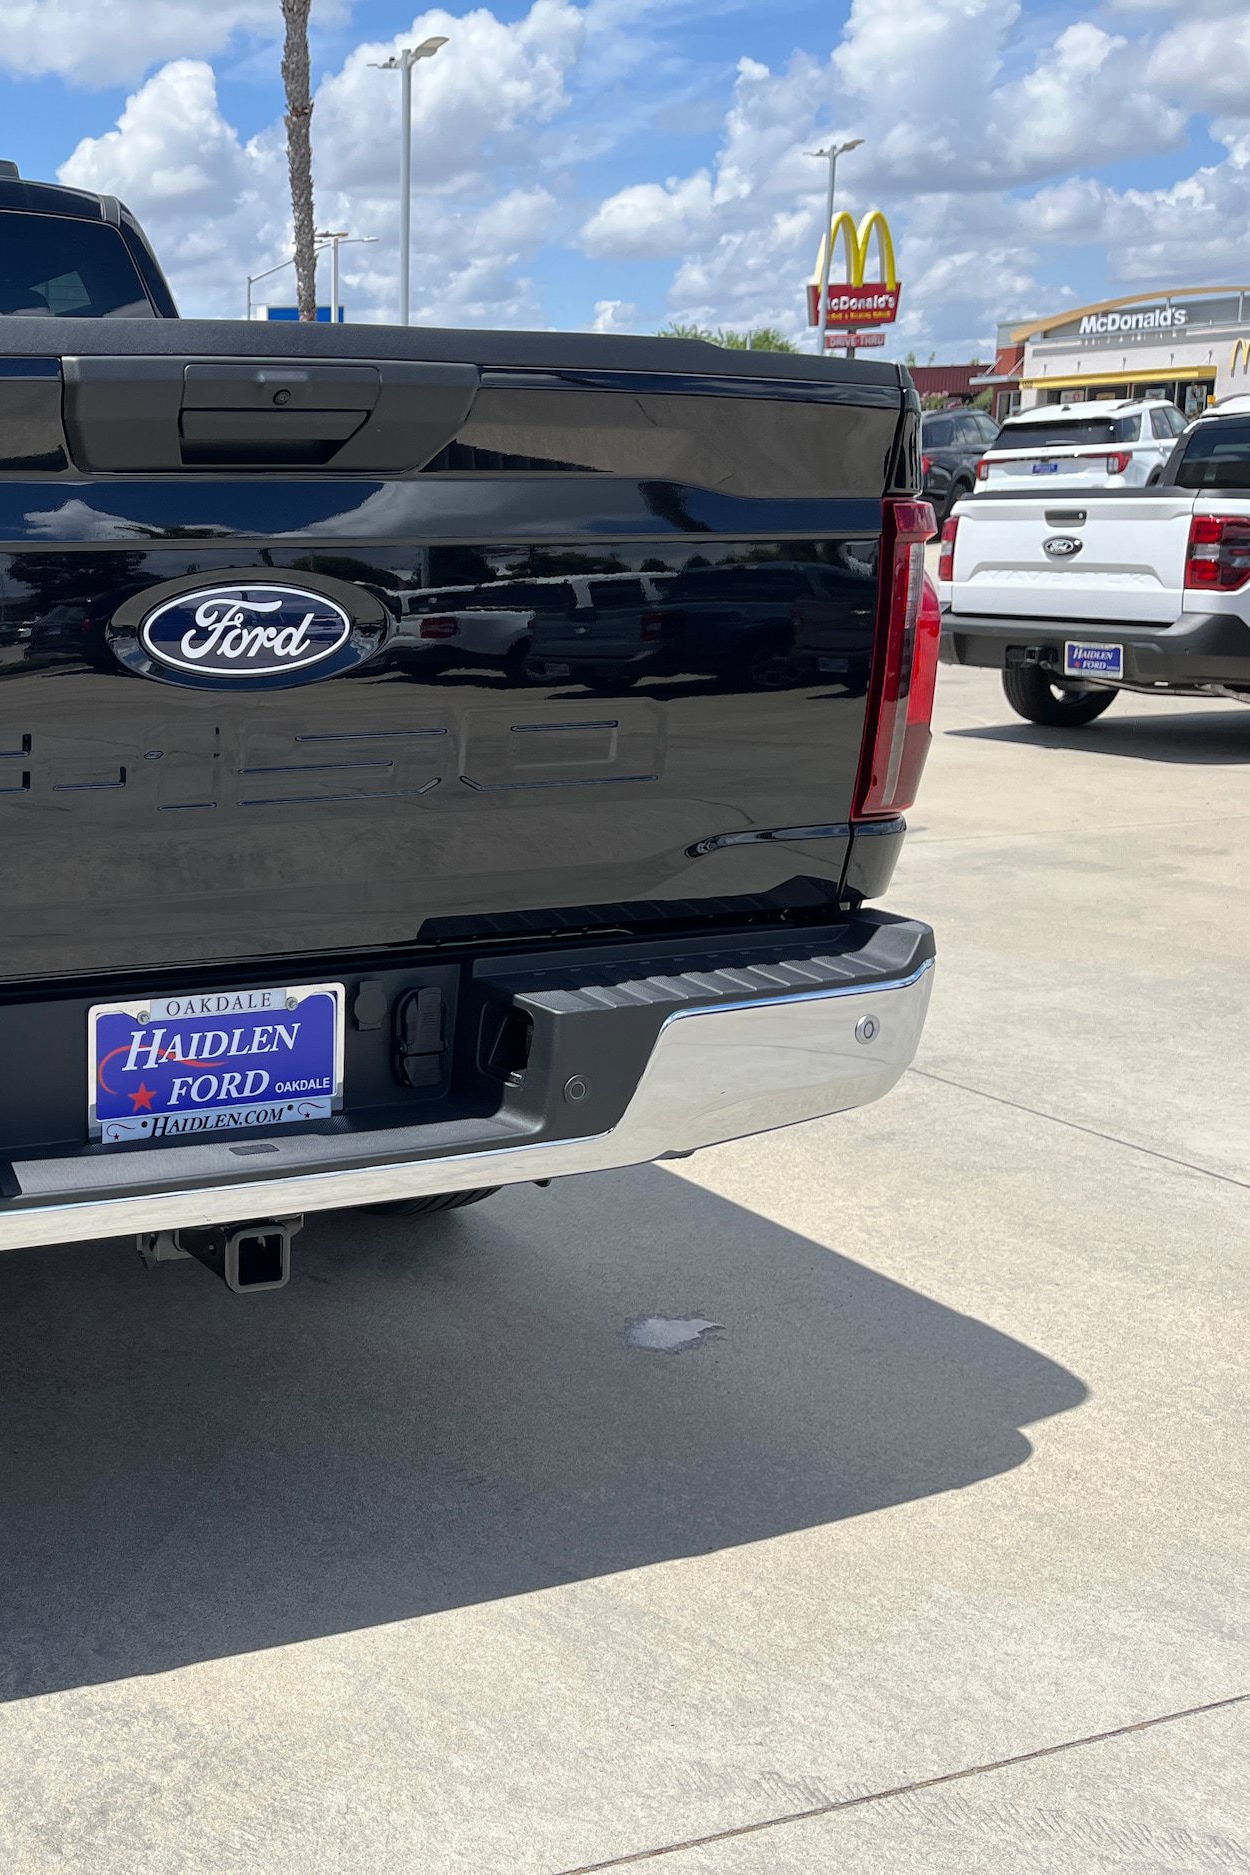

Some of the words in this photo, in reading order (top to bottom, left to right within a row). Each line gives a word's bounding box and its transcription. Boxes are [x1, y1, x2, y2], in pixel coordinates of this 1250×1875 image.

[1079, 307, 1187, 334] McDonald's
[181, 599, 315, 658] Ford
[1073, 647, 1113, 661] HAIDLEN
[1082, 660, 1107, 670] FORD
[166, 992, 272, 1017] OAKDALE
[121, 1022, 301, 1072] HAIDLEN
[166, 1070, 270, 1106] FORD
[275, 1077, 331, 1094] OAKDALE
[150, 1107, 285, 1138] HAIDLEN.COM
